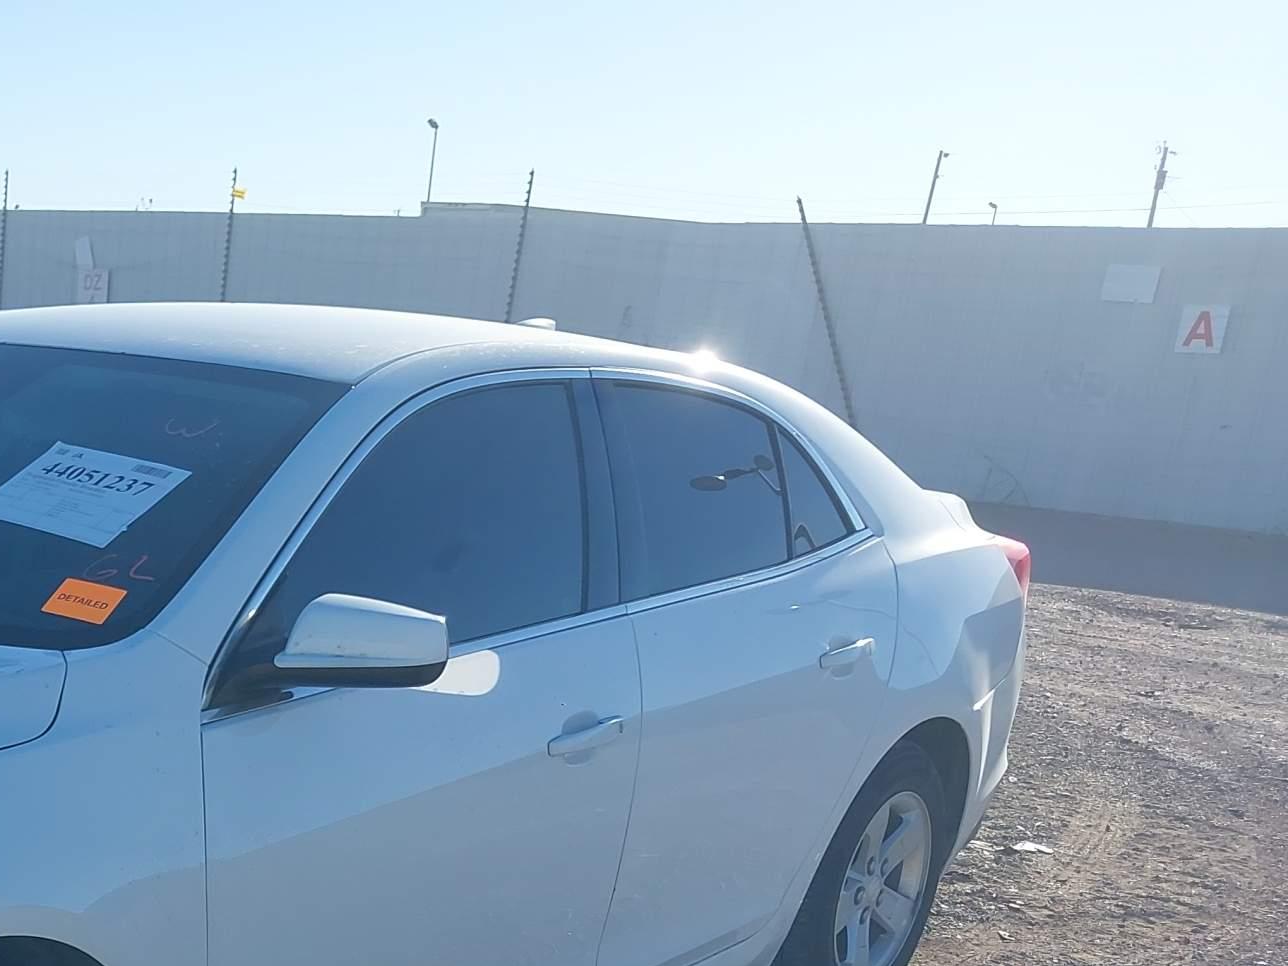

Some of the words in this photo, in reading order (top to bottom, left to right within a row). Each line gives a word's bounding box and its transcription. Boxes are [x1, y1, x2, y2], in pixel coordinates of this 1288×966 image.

[1182, 311, 1213, 347] A
[42, 462, 156, 496] 44051237
[57, 593, 109, 610] DETAILED
